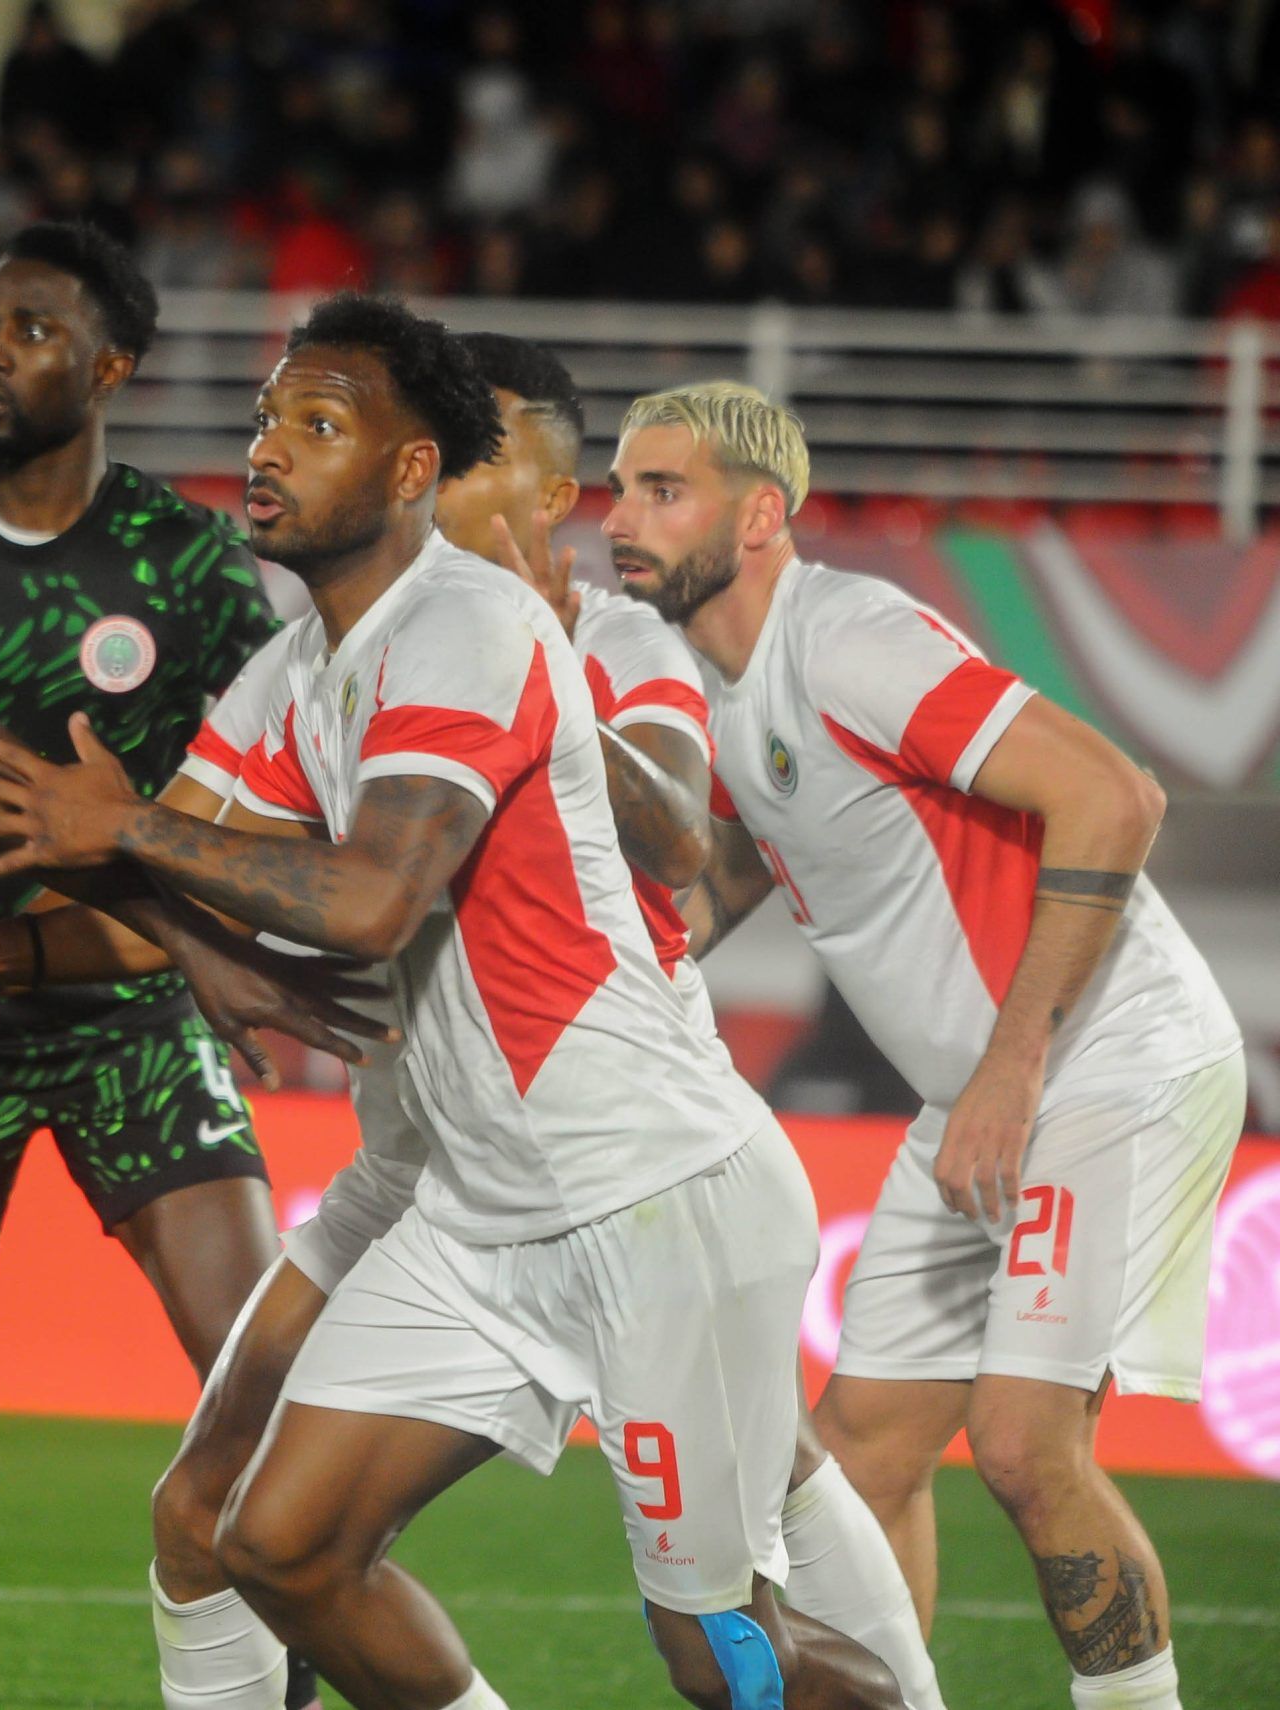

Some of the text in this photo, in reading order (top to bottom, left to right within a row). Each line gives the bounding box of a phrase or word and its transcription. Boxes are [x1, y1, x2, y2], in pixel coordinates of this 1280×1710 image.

[197, 1038, 245, 1113] 4
[1007, 1184, 1075, 1280] 21
[624, 1421, 683, 1521] 9
[644, 1547, 696, 1567] Lacatoni
